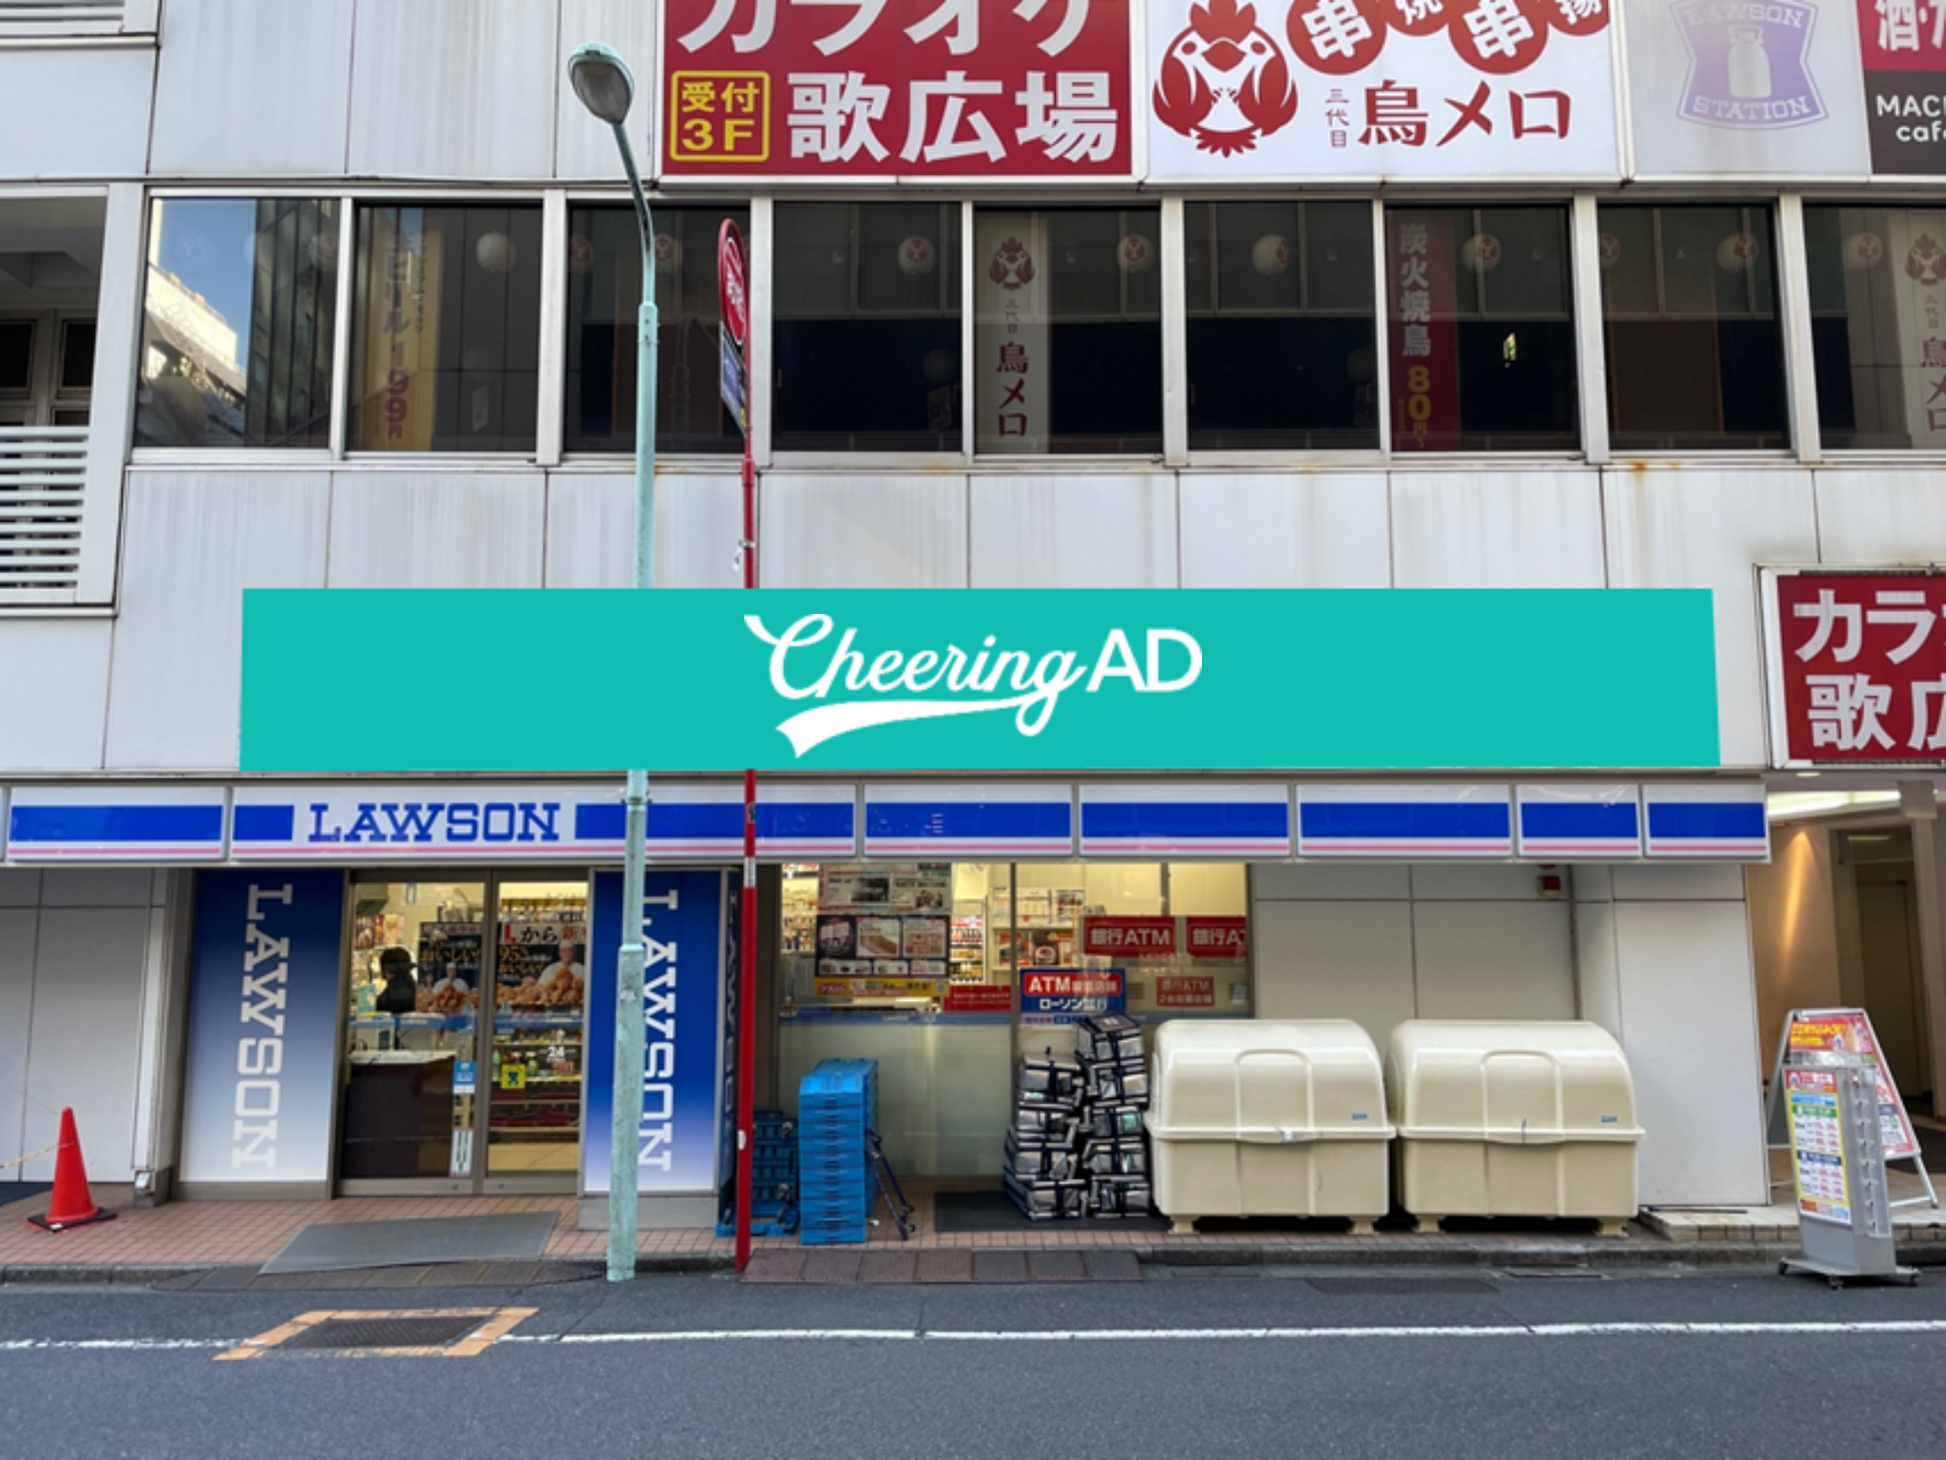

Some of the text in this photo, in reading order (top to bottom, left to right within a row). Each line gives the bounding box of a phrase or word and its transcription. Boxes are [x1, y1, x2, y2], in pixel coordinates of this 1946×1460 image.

[1301, 0, 1373, 59] 串
[1462, 0, 1534, 59] 串
[1684, 3, 1804, 28] LAWSON
[1874, 0, 1946, 52] 酒・
[681, 81, 760, 114] 受付
[787, 71, 1118, 163] 歌広場
[1325, 88, 1350, 148] 三代目
[1358, 79, 1572, 148] 鳥メロ
[1693, 96, 1811, 120] STATION
[1876, 94, 1946, 118] MAC
[682, 119, 756, 151] 3F
[1896, 121, 1946, 143] caf
[1400, 223, 1432, 357] 炭火焼鳥
[996, 341, 1029, 437] 鳥メロ
[1793, 588, 1946, 665] カラ
[308, 803, 561, 842] LAWSON
[232, 884, 293, 1170] LAWSON
